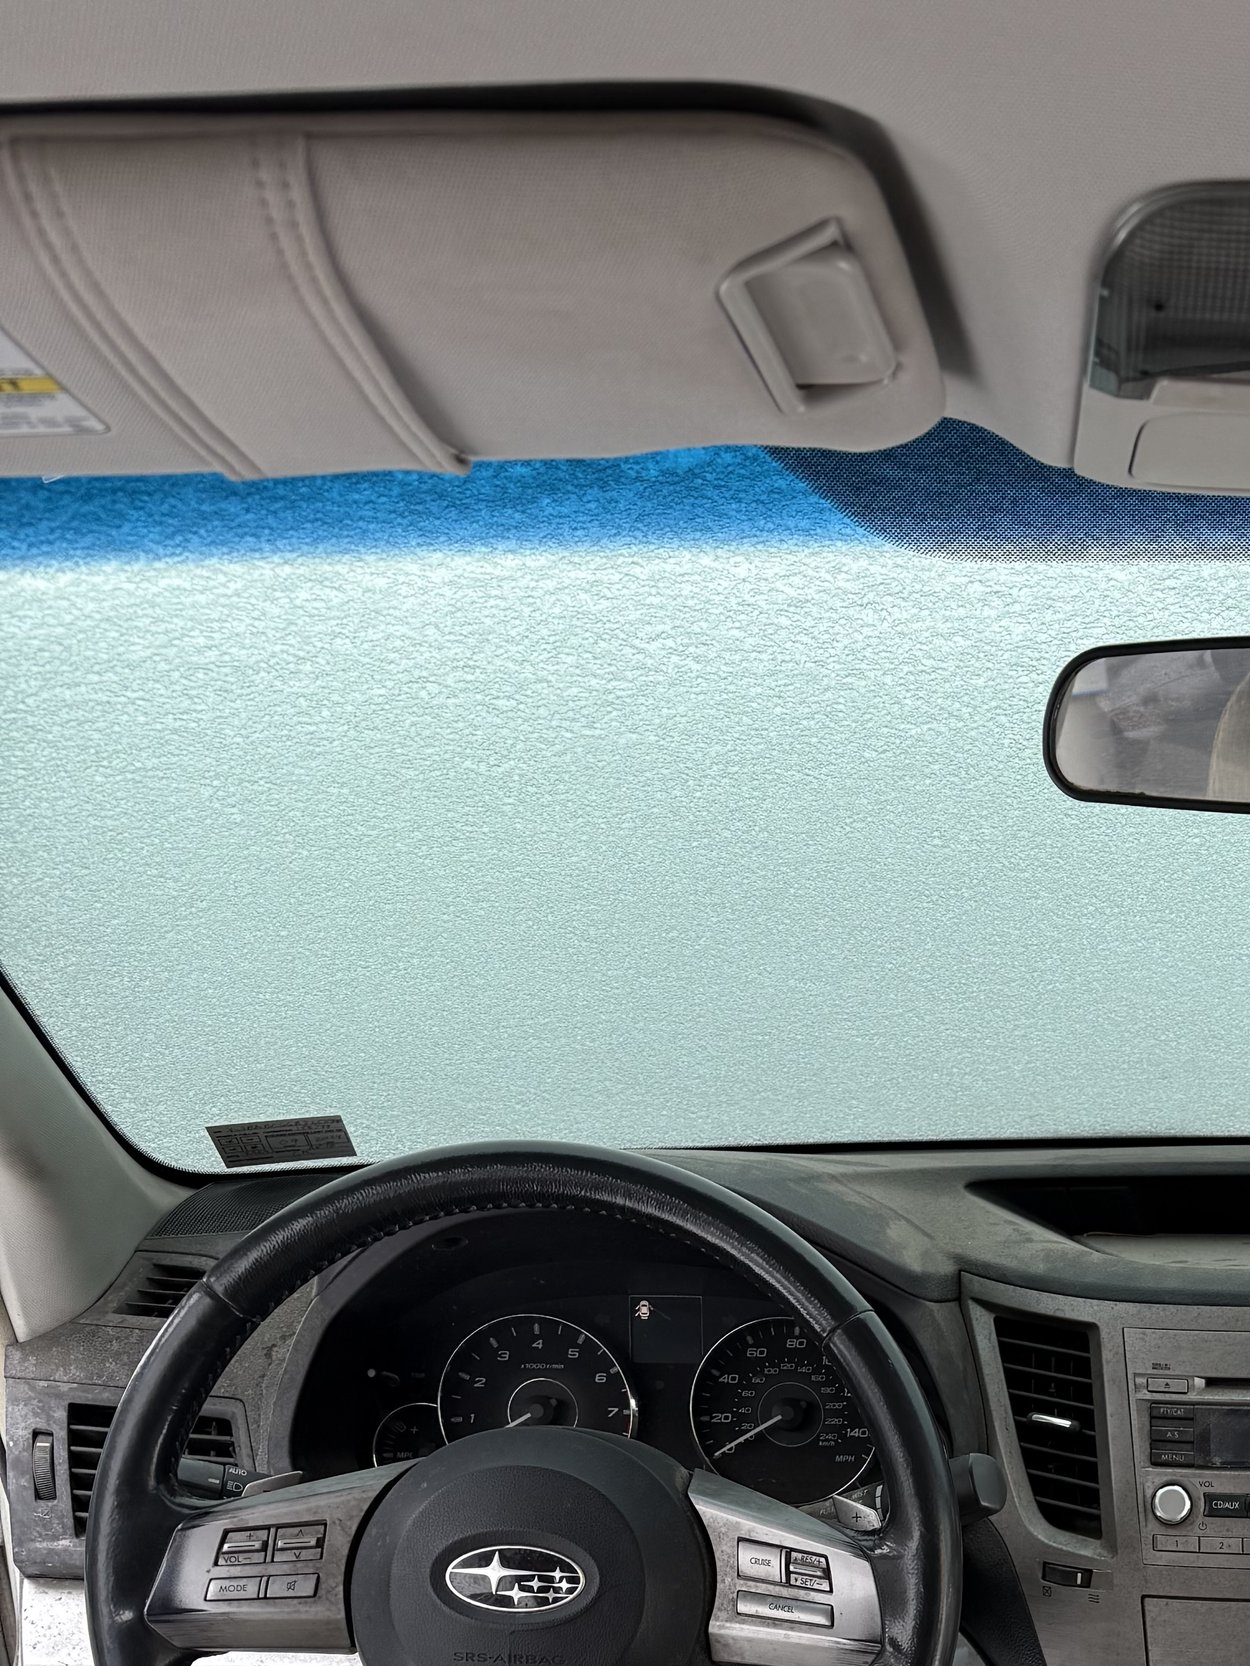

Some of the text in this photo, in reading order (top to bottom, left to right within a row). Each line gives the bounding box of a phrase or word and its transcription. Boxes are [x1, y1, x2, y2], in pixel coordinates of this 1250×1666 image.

[532, 1340, 543, 1349] 4
[786, 1339, 806, 1348] 80
[497, 1351, 509, 1360] 3
[568, 1349, 579, 1358] 5
[747, 1348, 767, 1357] 60
[474, 1377, 486, 1387] 2
[595, 1373, 607, 1383] 6
[718, 1374, 738, 1383] 40
[608, 1408, 619, 1417] 7
[470, 1414, 475, 1423] 1
[711, 1413, 732, 1423] 20
[847, 1428, 870, 1437] 140
[1161, 1454, 1185, 1462] MENU
[229, 1466, 247, 1476] AUTO
[1212, 1501, 1240, 1509] CD/AUX
[749, 1557, 772, 1567] CRUISE
[218, 1584, 249, 1593] MODE
[768, 1602, 795, 1614] CANCEL
[453, 1652, 565, 1665] SRS-AIRBAG
